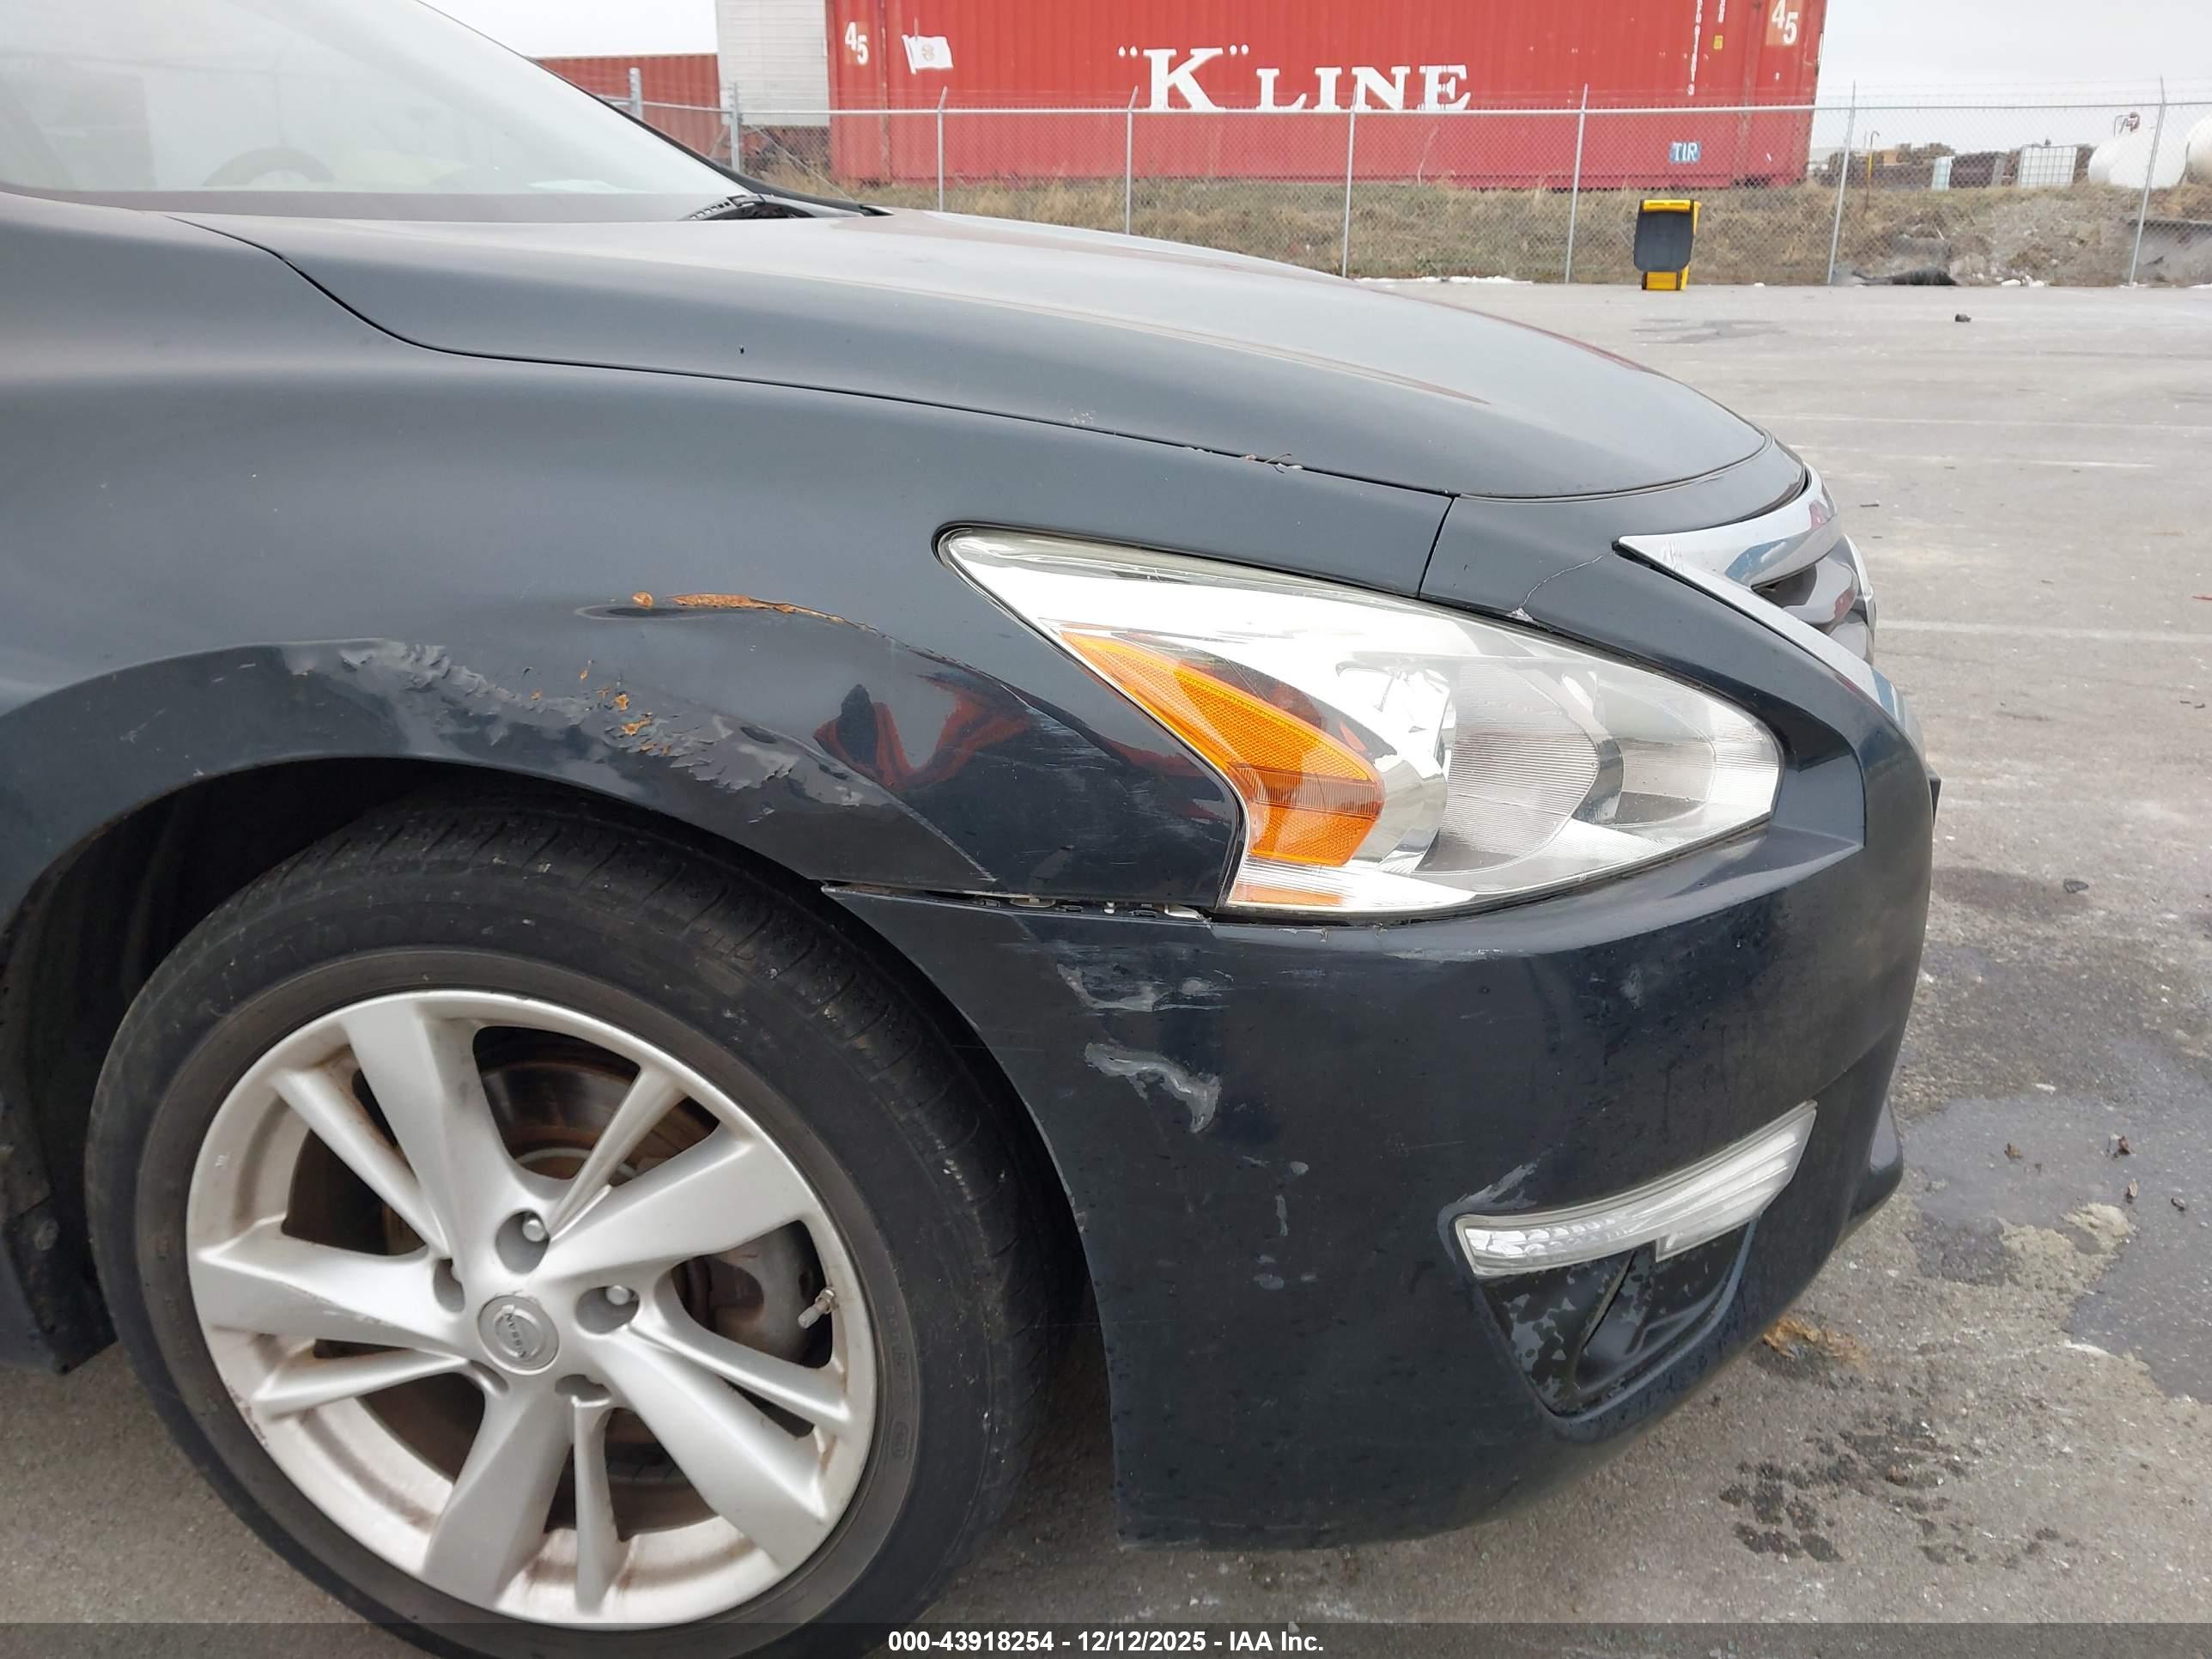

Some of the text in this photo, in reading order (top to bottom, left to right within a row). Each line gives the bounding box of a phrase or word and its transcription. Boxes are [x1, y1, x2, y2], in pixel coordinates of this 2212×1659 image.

[845, 21, 869, 65] 45
[1771, 0, 1799, 45] 45
[1255, 64, 1471, 111] LINE
[1673, 142, 1698, 161] TIR
